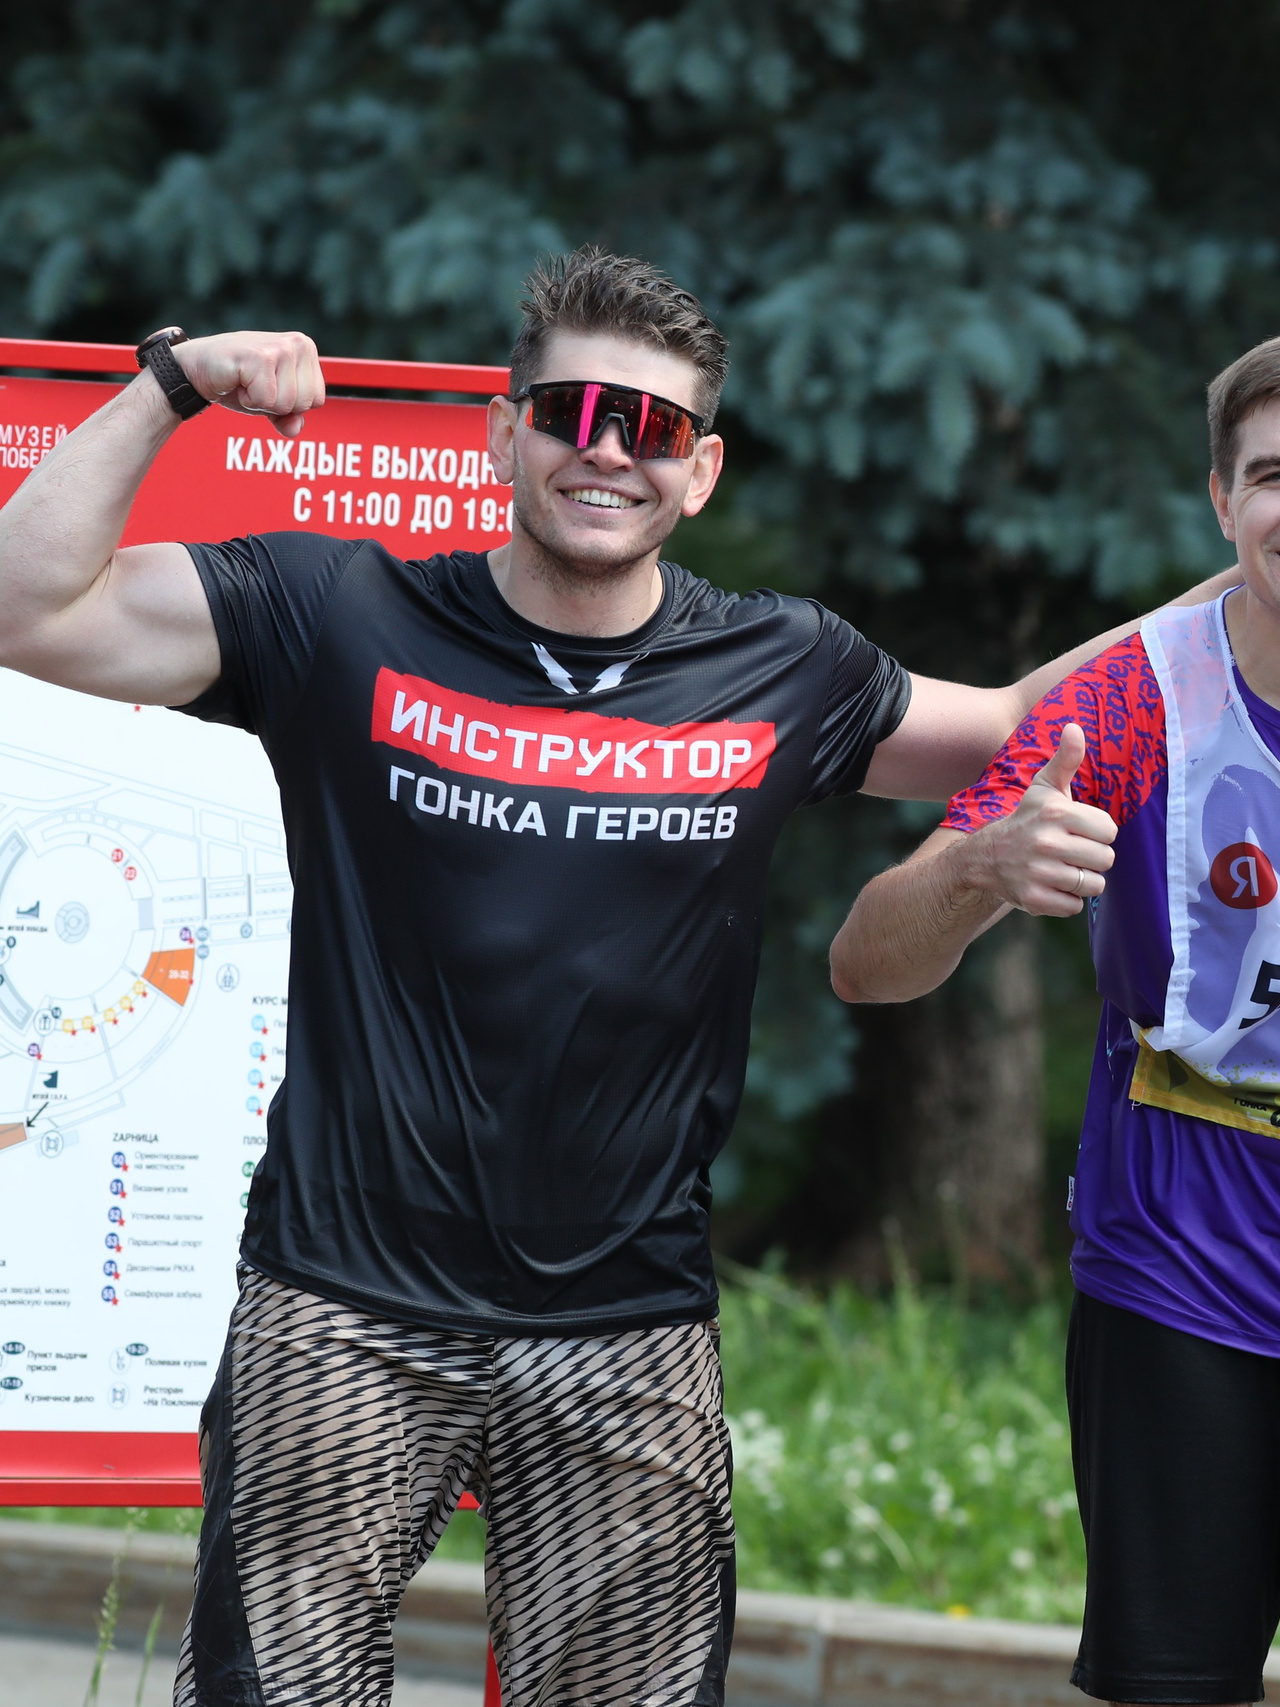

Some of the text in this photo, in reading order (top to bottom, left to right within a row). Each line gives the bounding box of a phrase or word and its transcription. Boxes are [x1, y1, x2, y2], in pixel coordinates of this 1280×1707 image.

[0, 424, 68, 447] МУЗЕЙ
[226, 436, 501, 490] КАЖДЫЕ ВЫХОДН
[293, 487, 311, 522] С
[322, 490, 400, 527] 11:00
[410, 494, 452, 534] ДО
[1103, 654, 1138, 752] Yandex
[390, 690, 752, 779] ИНСТРУКТОР
[389, 765, 738, 841] ГОНКА ГЕРОЕВ
[1230, 857, 1259, 899] Я
[252, 996, 278, 1006] КУРС
[131, 1212, 170, 1221] Установка
[27, 1351, 88, 1361] Пункт выдачи
[145, 1357, 180, 1366] Полевая
[26, 1364, 57, 1373] призов
[25, 1393, 95, 1404] Кузнечное дело
[143, 1385, 184, 1395] Ресторан
